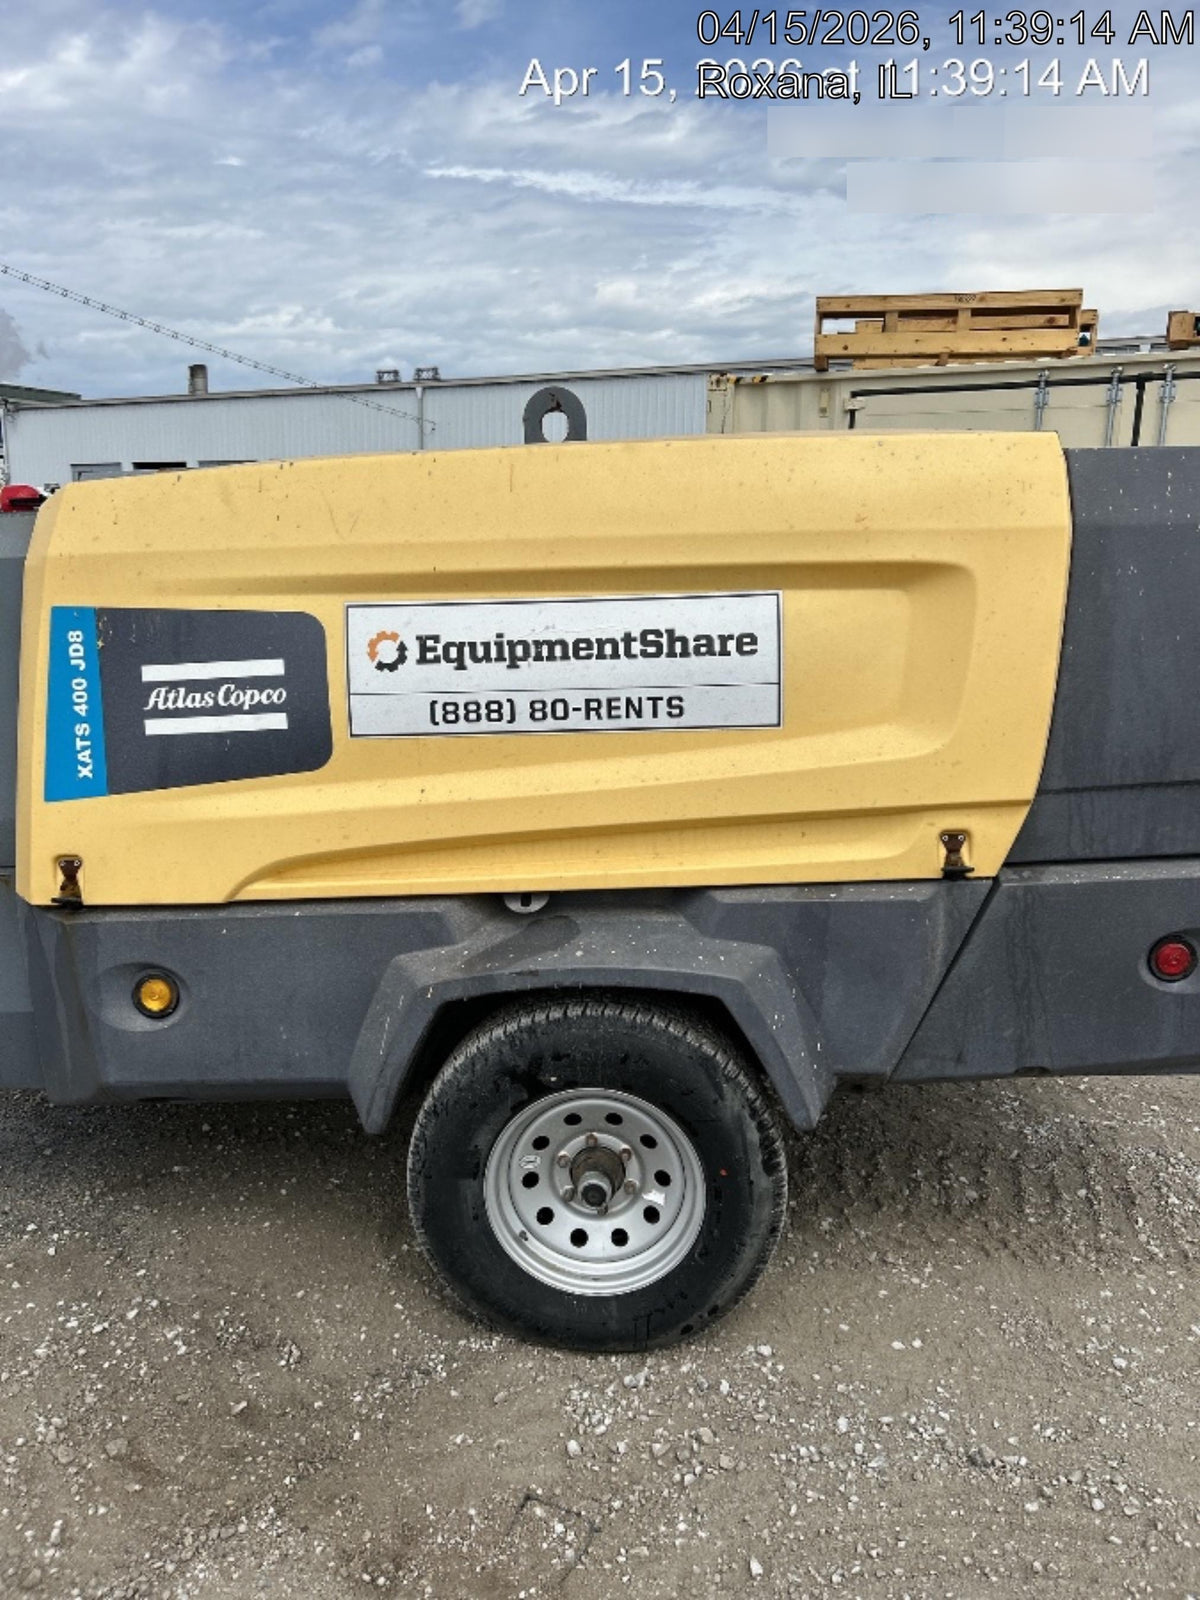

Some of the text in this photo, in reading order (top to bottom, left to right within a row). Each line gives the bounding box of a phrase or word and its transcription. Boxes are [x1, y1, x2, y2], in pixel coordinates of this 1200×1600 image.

[415, 629, 759, 670] EquipmentShare
[67, 630, 93, 780] XATS 400 JD8
[144, 684, 287, 711] Atlas Copco
[429, 696, 685, 725] (888) 80-RENTS
